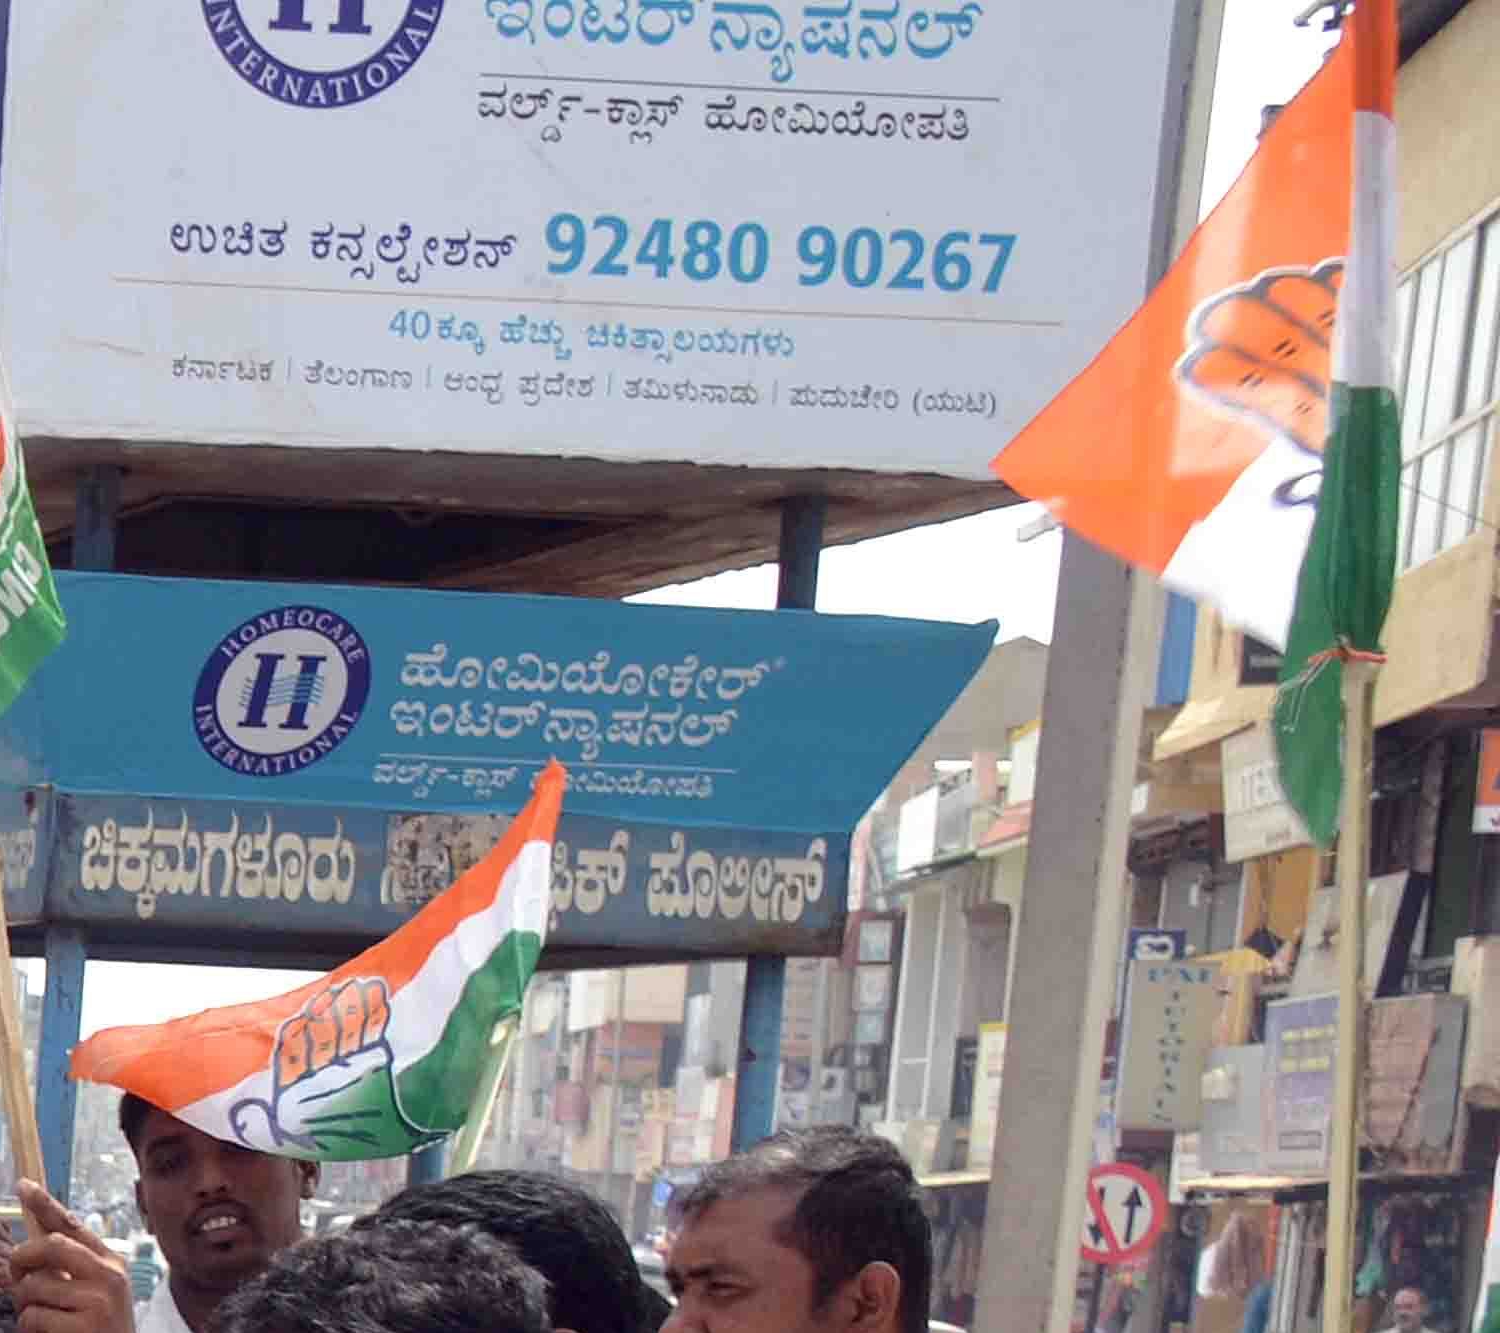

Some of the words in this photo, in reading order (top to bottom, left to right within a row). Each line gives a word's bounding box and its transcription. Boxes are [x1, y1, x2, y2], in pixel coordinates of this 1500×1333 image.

[704, 96, 971, 140] ಹೋಮಿಯೋಪತಿ
[169, 219, 289, 259] ಉಚಿತ
[545, 212, 770, 283] 92480
[796, 225, 1017, 293] 90267
[172, 354, 274, 383] ಕರ್ನಾಟಕ
[220, 608, 365, 665] HOMEOCARE
[400, 642, 771, 705] ಹೋಮಿಯೋಕೇರ್
[195, 702, 359, 775] INTERNATIONAL
[80, 806, 357, 920] ಚಿಕ್ಕಮಗಳೂರು
